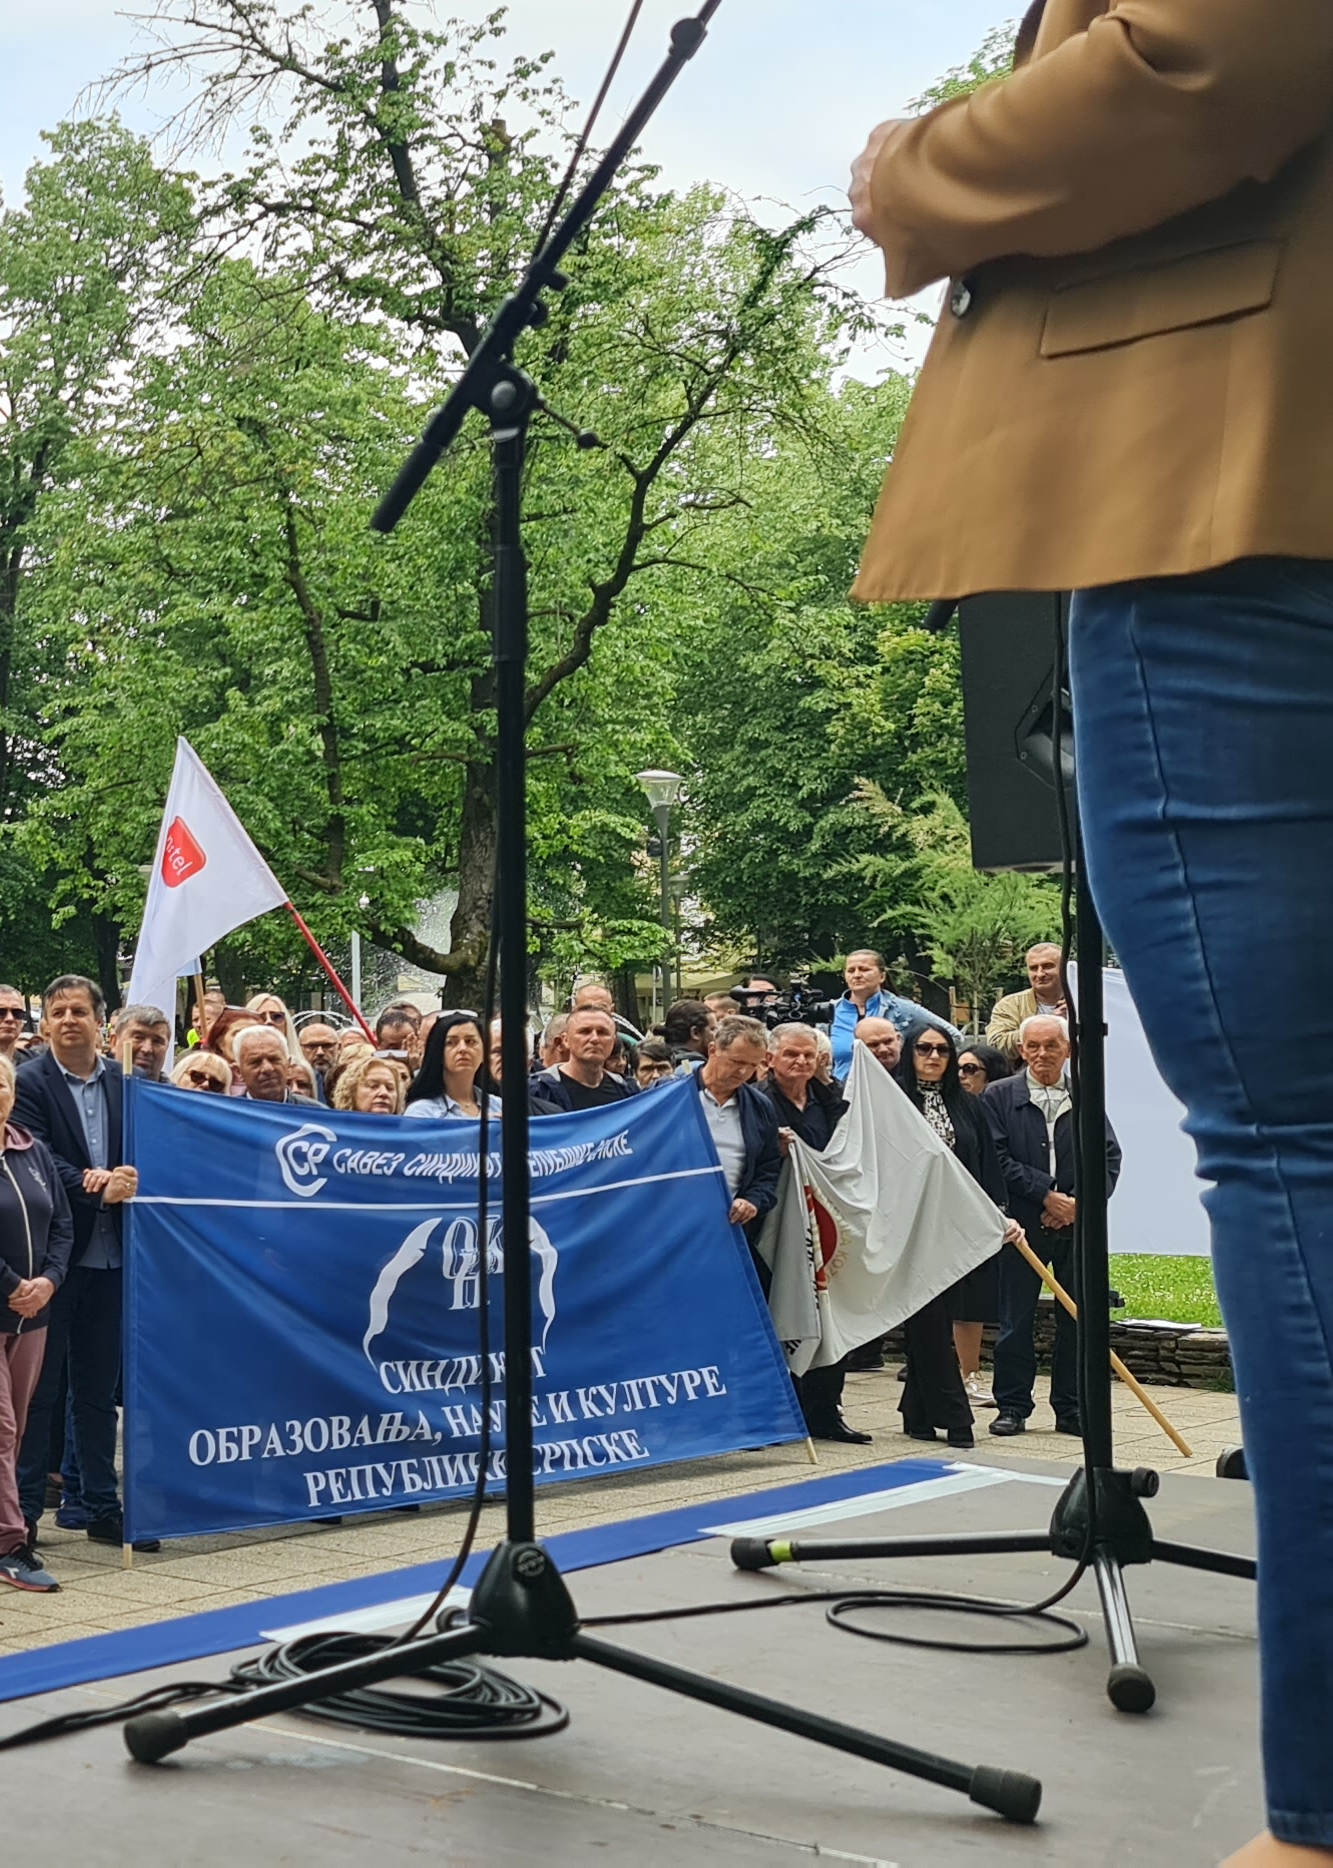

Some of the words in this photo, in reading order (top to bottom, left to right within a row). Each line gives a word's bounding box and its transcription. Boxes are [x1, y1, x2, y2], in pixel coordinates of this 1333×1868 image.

[333, 1148, 406, 1176] САВЕЗ
[380, 1346, 547, 1397] СИНДИКТ
[189, 1410, 442, 1466] ОБРАЗОВАЊА,
[545, 1392, 577, 1424] И
[576, 1365, 727, 1419] КУЛТУРЕ
